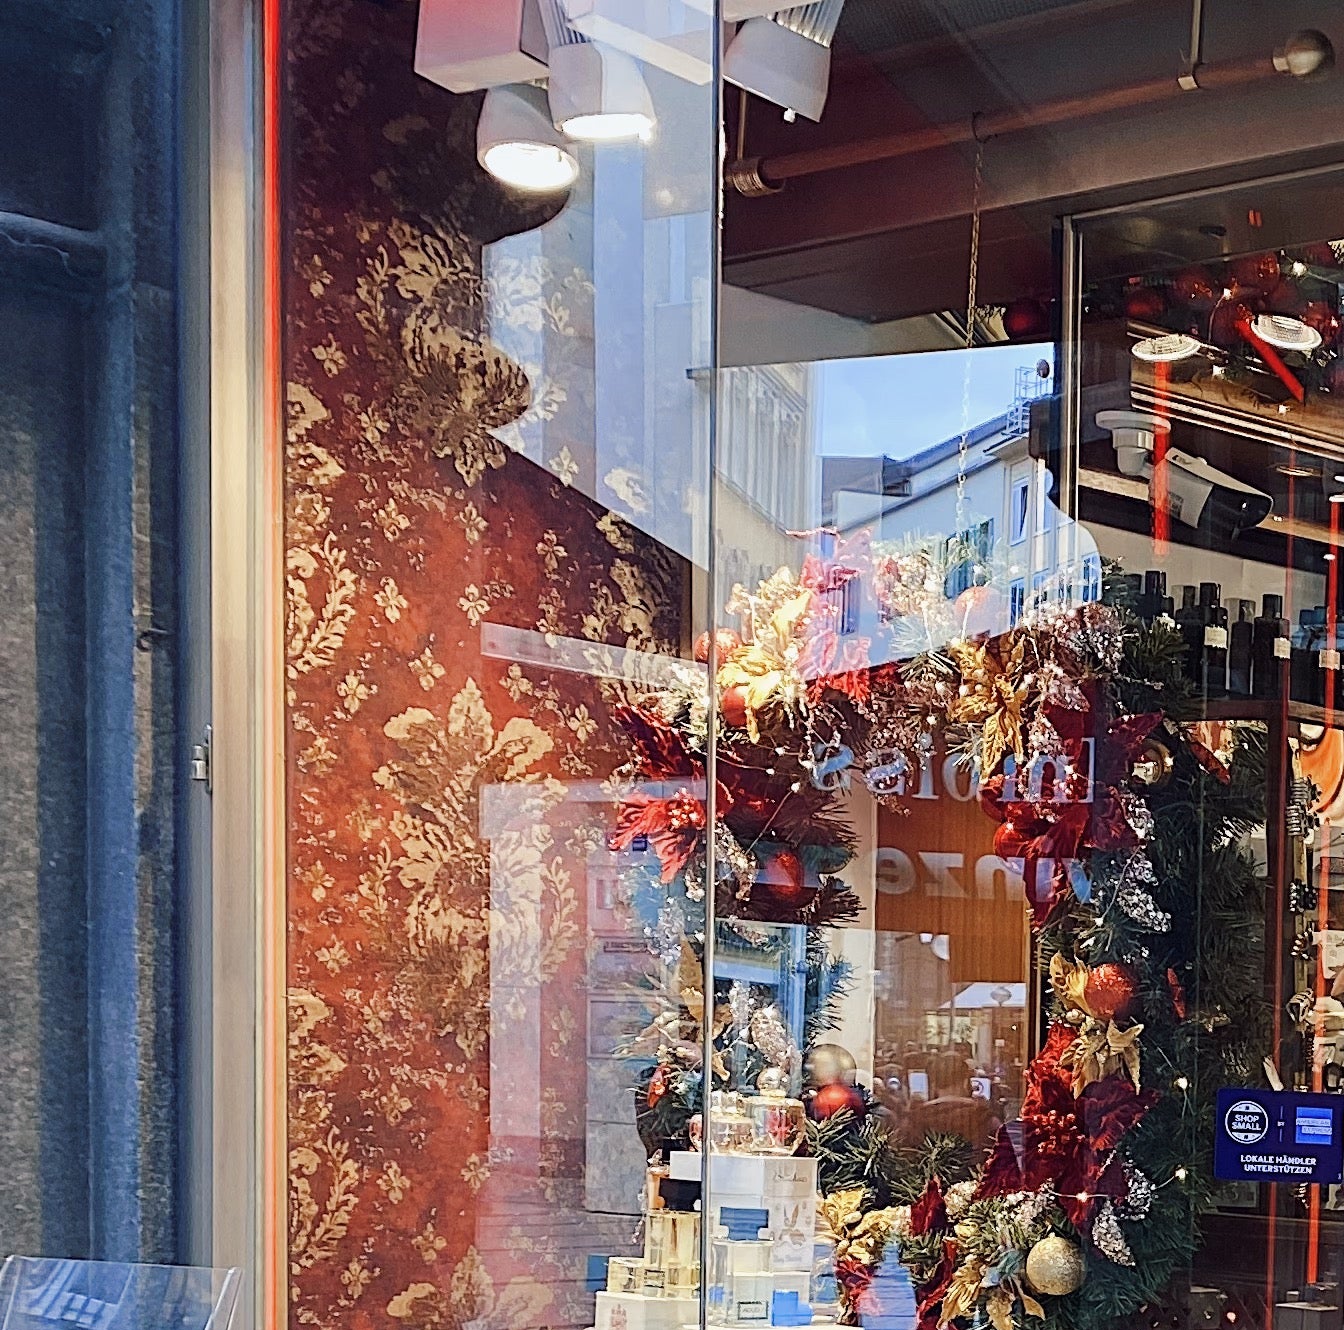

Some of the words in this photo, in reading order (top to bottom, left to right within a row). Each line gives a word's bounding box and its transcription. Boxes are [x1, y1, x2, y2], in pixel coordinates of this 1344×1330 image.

[1234, 1114, 1260, 1123] SHOP
[1231, 1121, 1262, 1132] SMALL
[1240, 1154, 1275, 1165] LOKALE
[1275, 1154, 1317, 1166] HÄNDLER
[1243, 1163, 1313, 1175] UNTERSTÜTZEN
